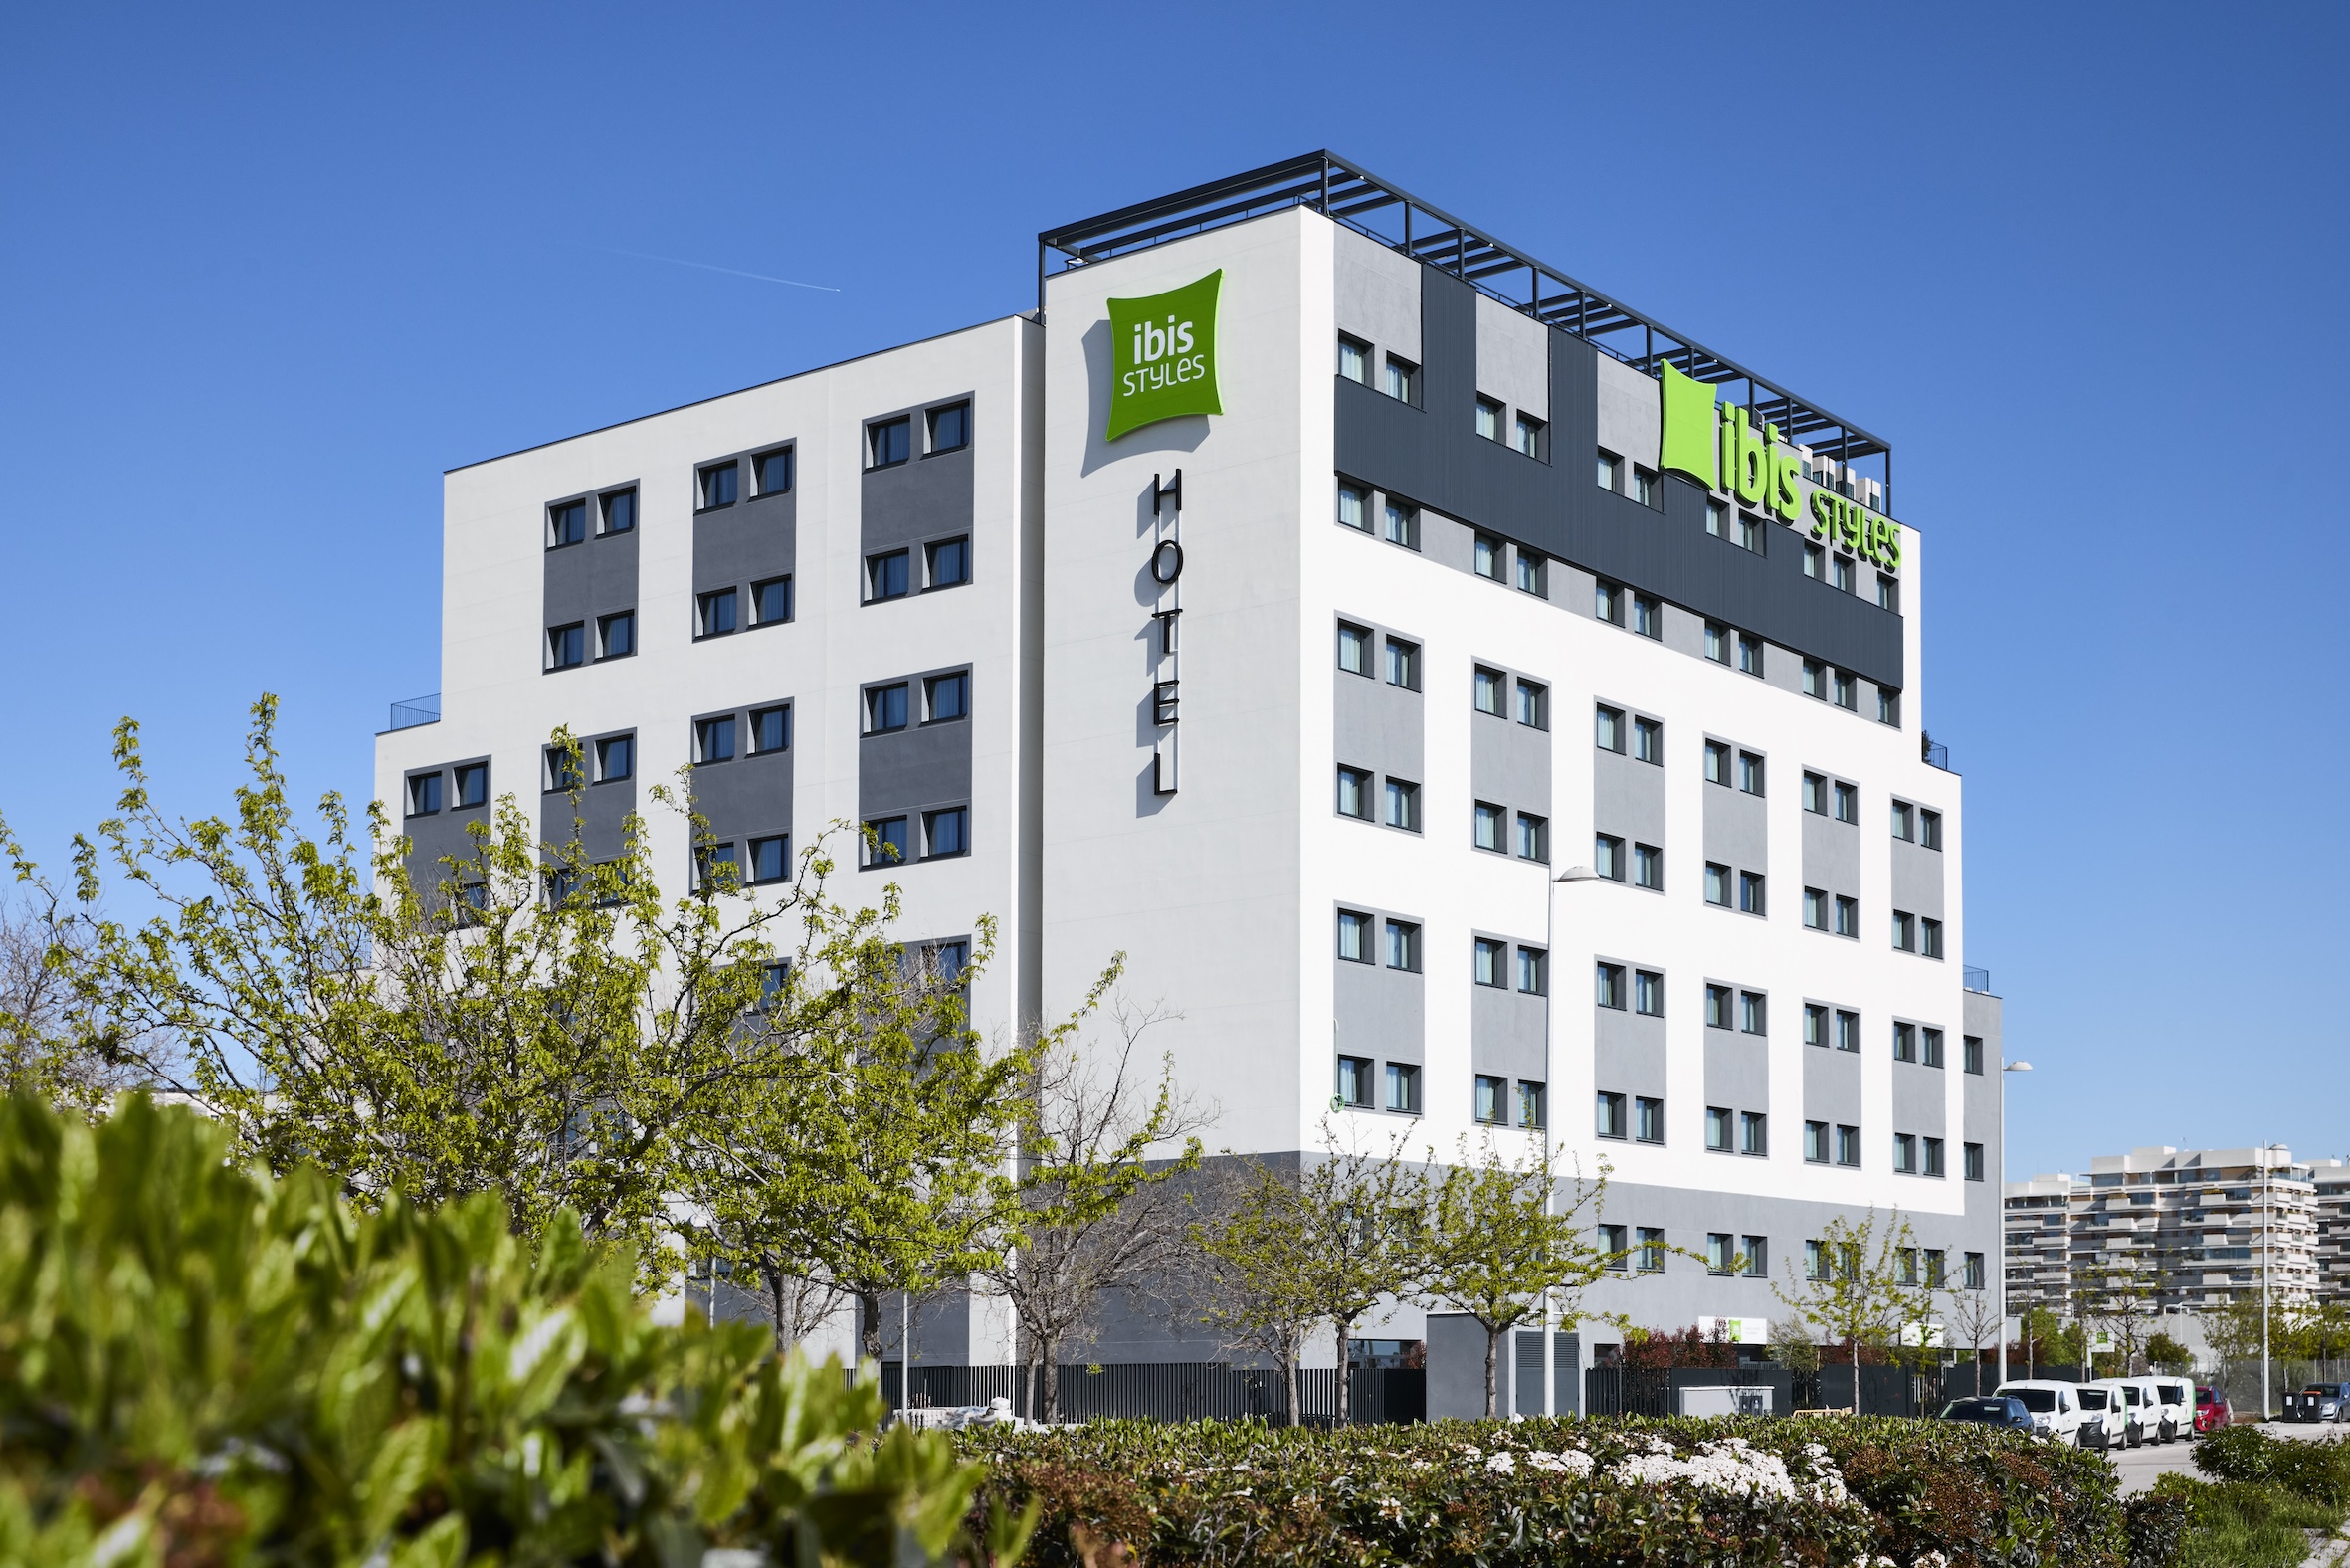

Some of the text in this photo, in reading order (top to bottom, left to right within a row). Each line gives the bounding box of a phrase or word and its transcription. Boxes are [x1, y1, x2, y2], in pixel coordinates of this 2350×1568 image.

[1133, 314, 1194, 365] ibis
[1721, 400, 1802, 520] ibis
[1151, 468, 1184, 796] HOTEL
